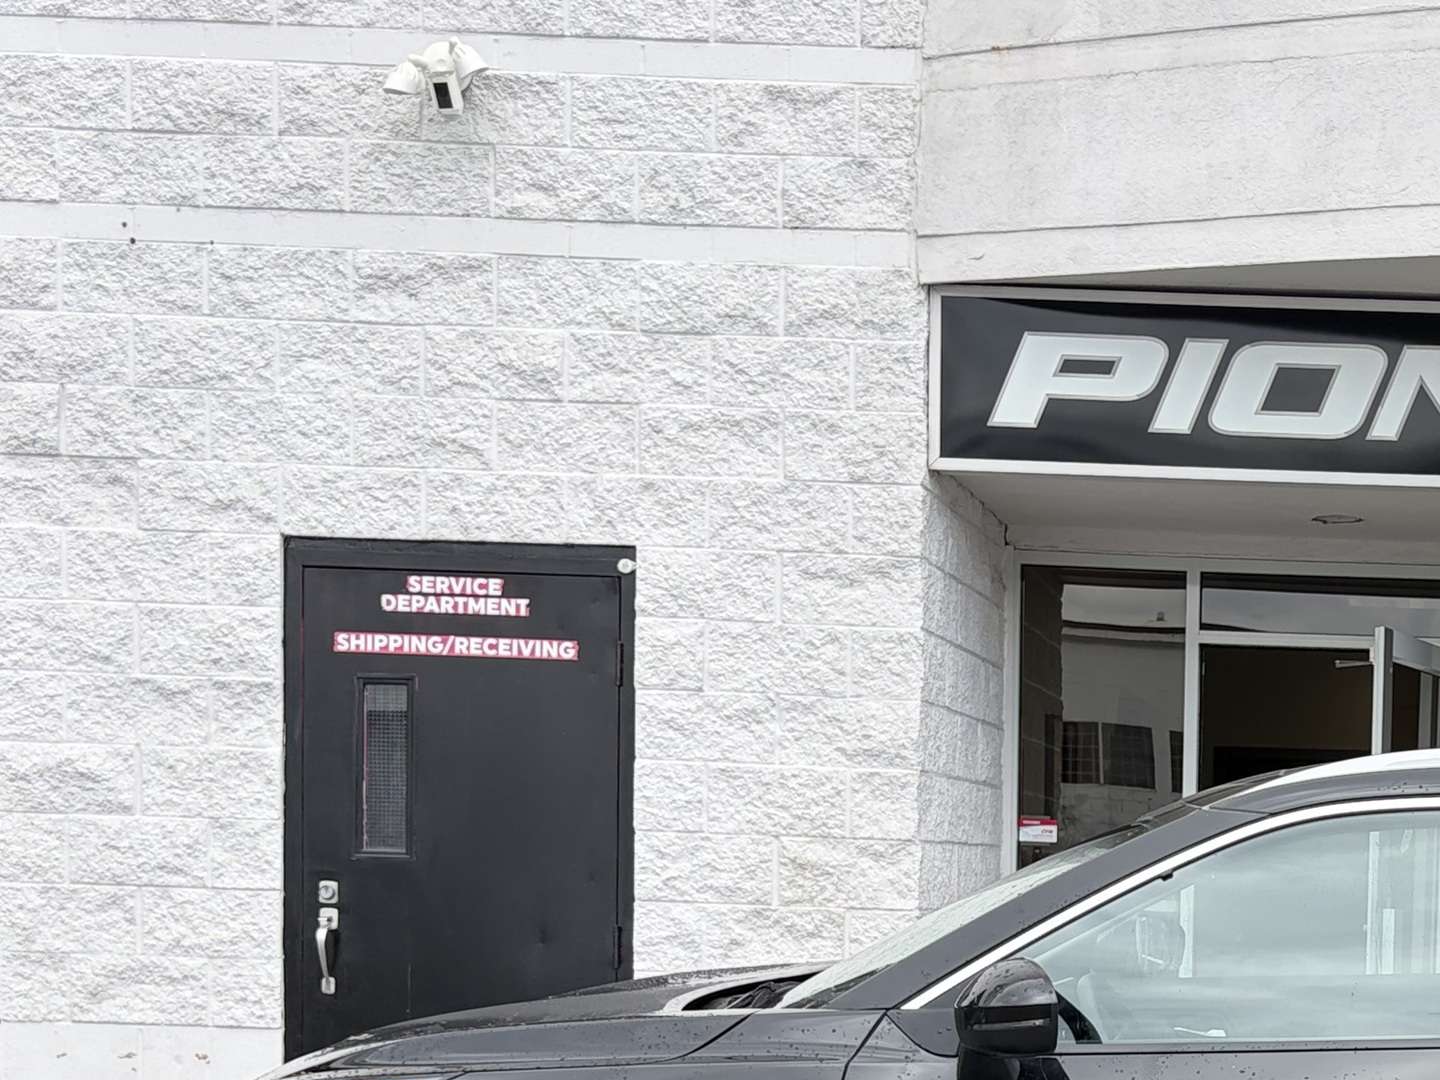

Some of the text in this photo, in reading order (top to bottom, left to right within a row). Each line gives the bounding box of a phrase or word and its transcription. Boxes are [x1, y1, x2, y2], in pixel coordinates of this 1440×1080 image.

[407, 575, 503, 596] SERVICE
[380, 594, 529, 617] DEPARTMENT
[336, 633, 577, 659] SHIPPING/RECEIVING
